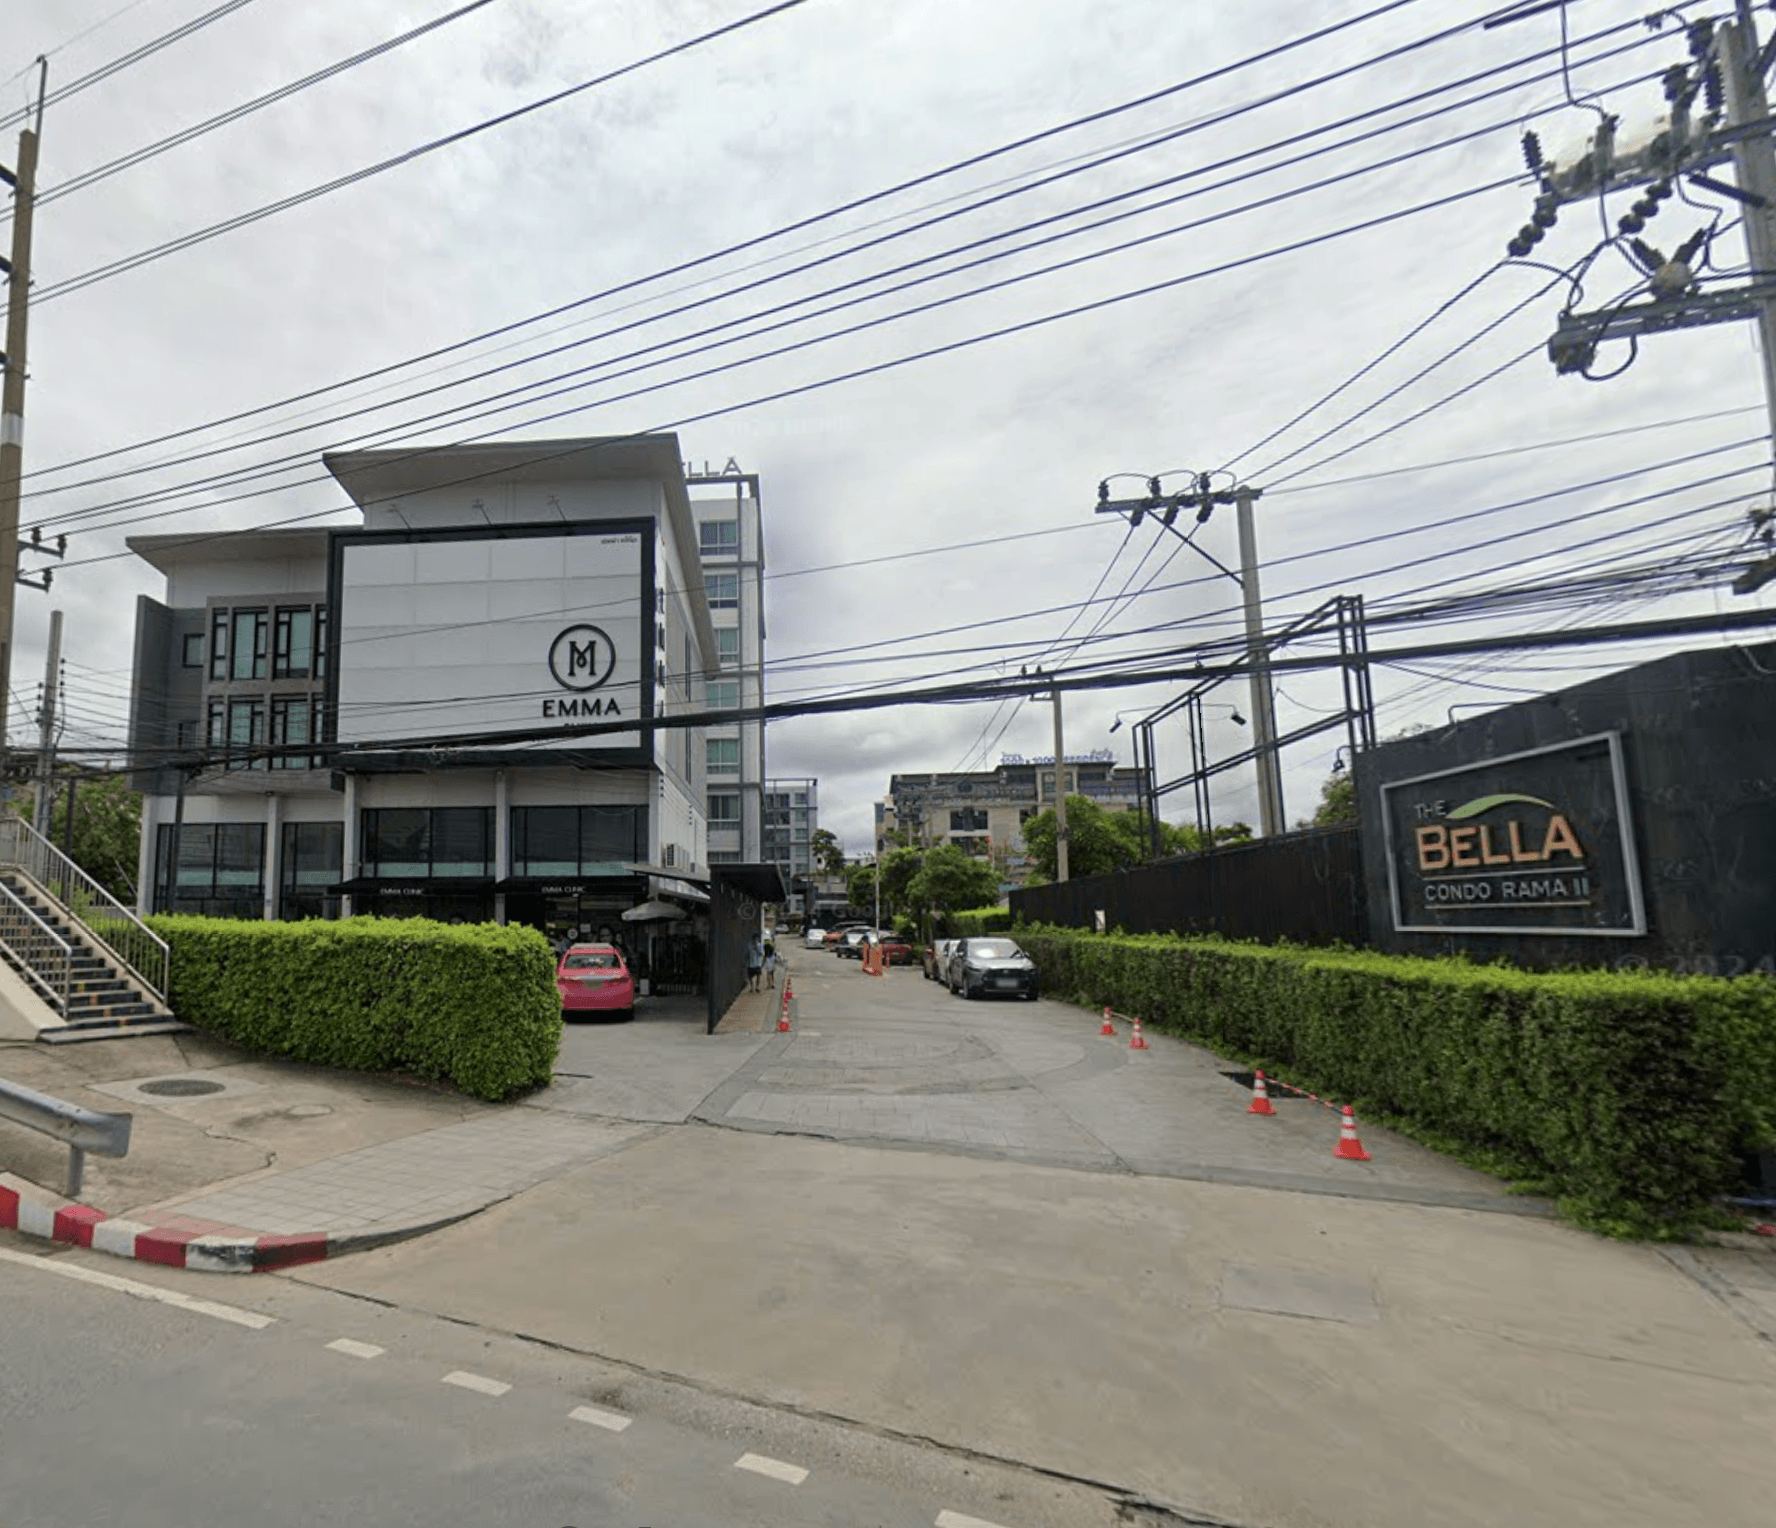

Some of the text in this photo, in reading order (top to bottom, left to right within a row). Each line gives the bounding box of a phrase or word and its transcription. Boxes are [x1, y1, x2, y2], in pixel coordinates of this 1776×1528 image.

[568, 640, 597, 676] M
[543, 698, 621, 717] EMMA
[1414, 800, 1447, 819] THE
[1416, 814, 1584, 871] BELLA
[1425, 877, 1590, 900] CONDO RAMA II
